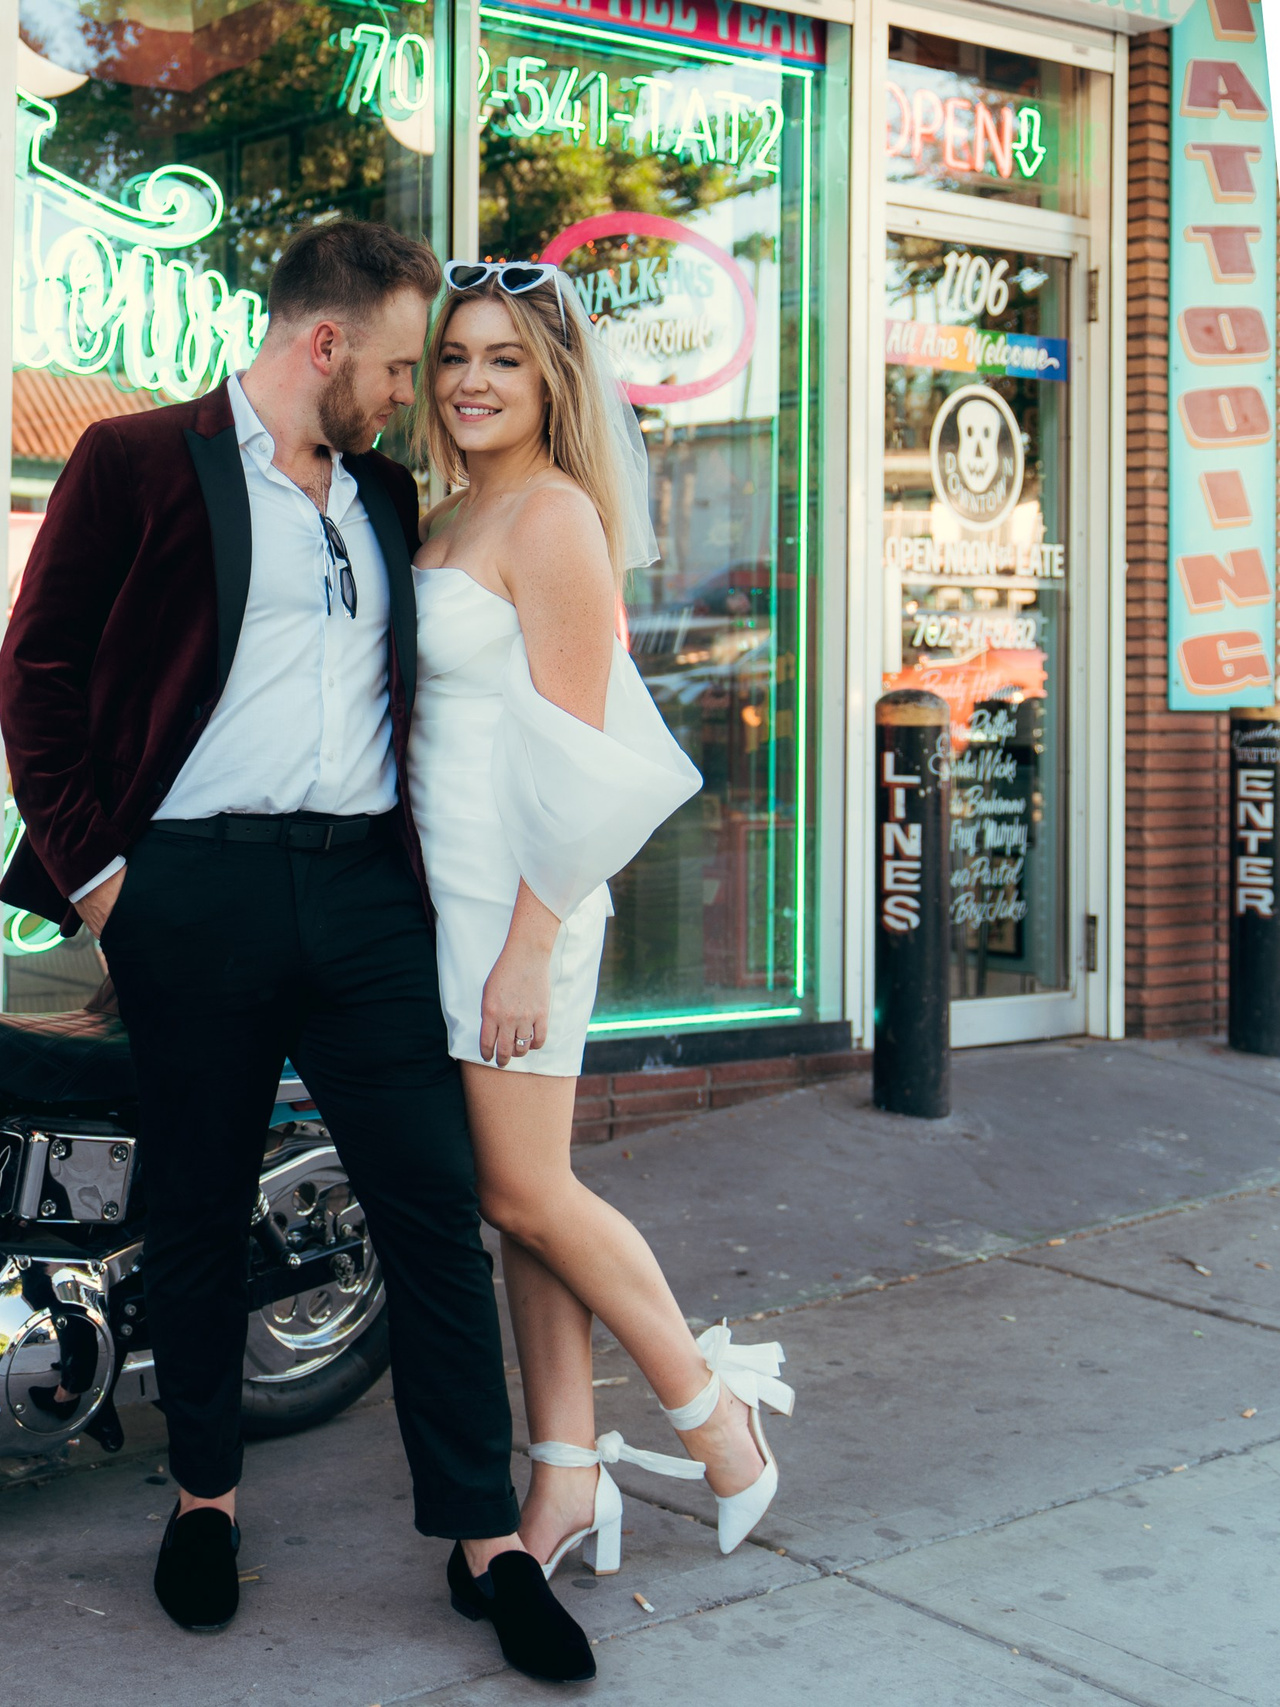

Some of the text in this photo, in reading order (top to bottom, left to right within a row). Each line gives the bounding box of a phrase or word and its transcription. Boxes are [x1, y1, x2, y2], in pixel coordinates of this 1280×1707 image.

[885, 81, 1014, 180] OPEN
[937, 250, 1009, 317] 1106
[886, 322, 1061, 371] All Are Welcome
[1015, 543, 1065, 578] LATE
[883, 750, 921, 931] LINES
[1236, 769, 1275, 915] ENTER
